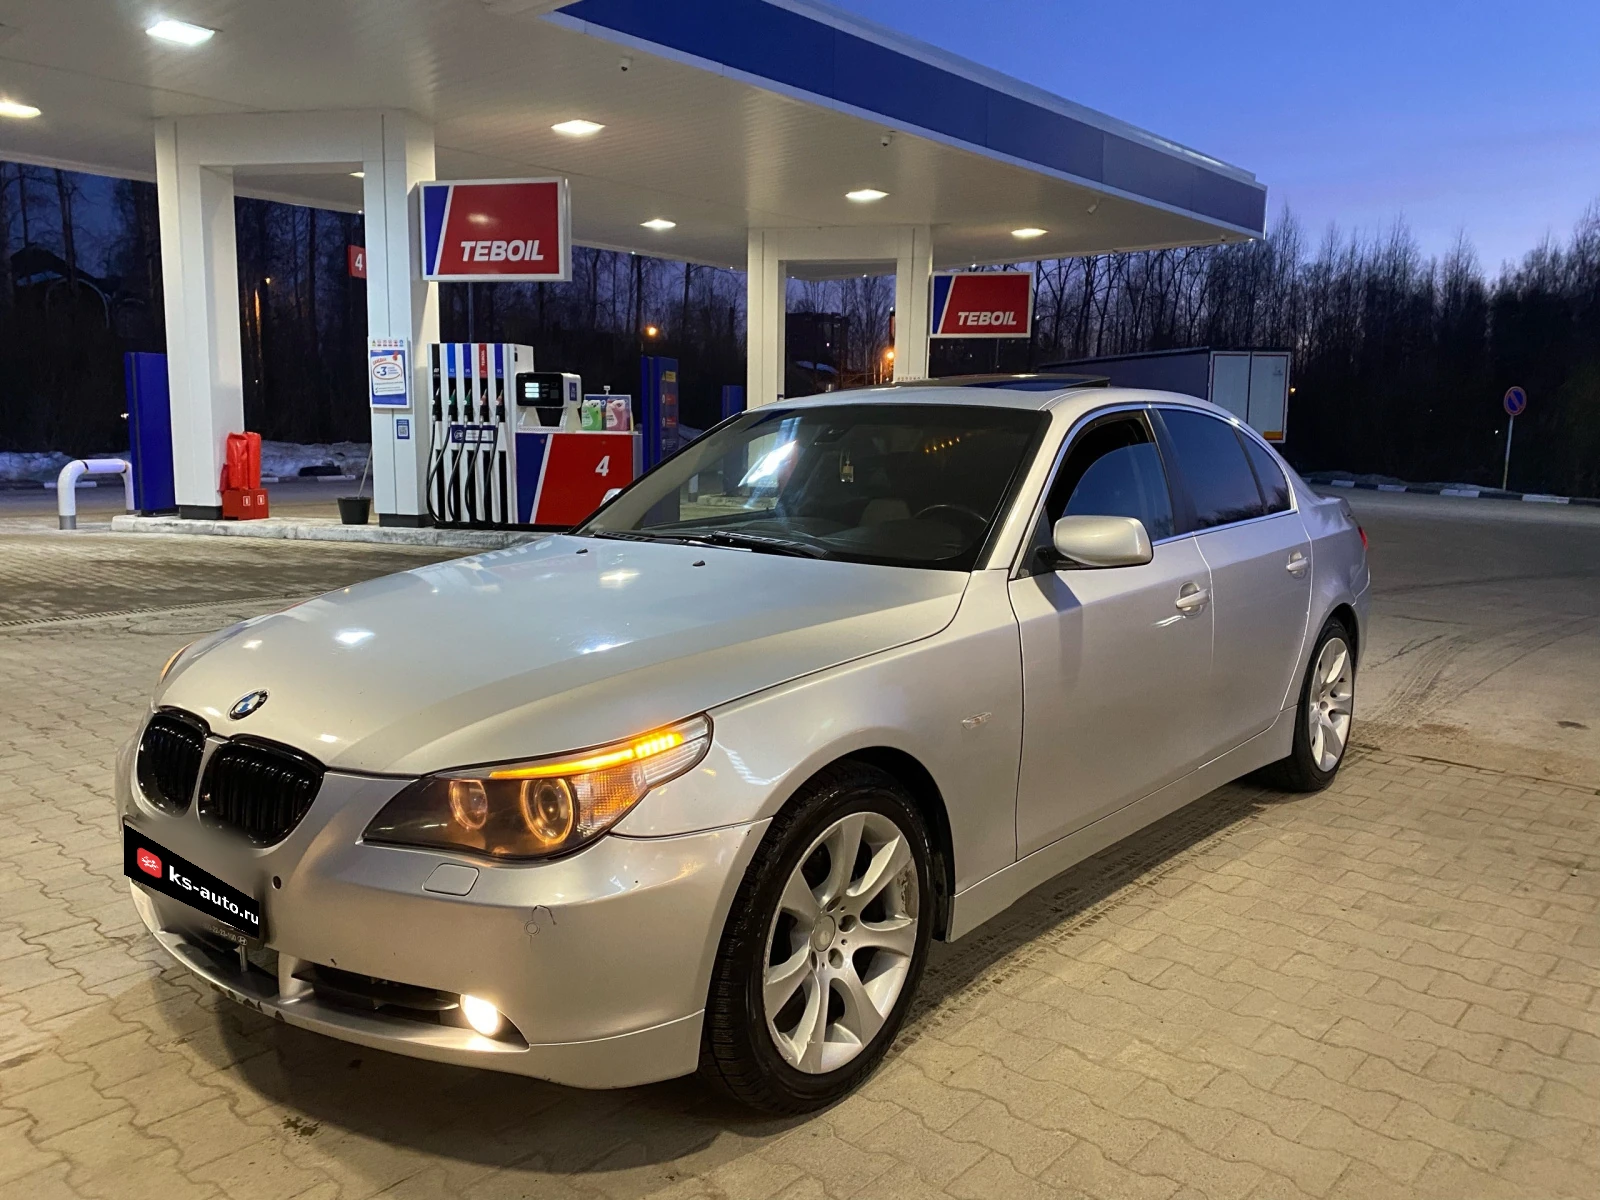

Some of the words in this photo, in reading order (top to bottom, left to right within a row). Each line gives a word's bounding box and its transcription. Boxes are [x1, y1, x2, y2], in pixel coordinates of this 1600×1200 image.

[460, 239, 544, 262] TEBOIL
[354, 253, 363, 271] 4
[958, 311, 1017, 326] TEBOIL
[376, 366, 387, 376] -3
[594, 455, 610, 477] 4
